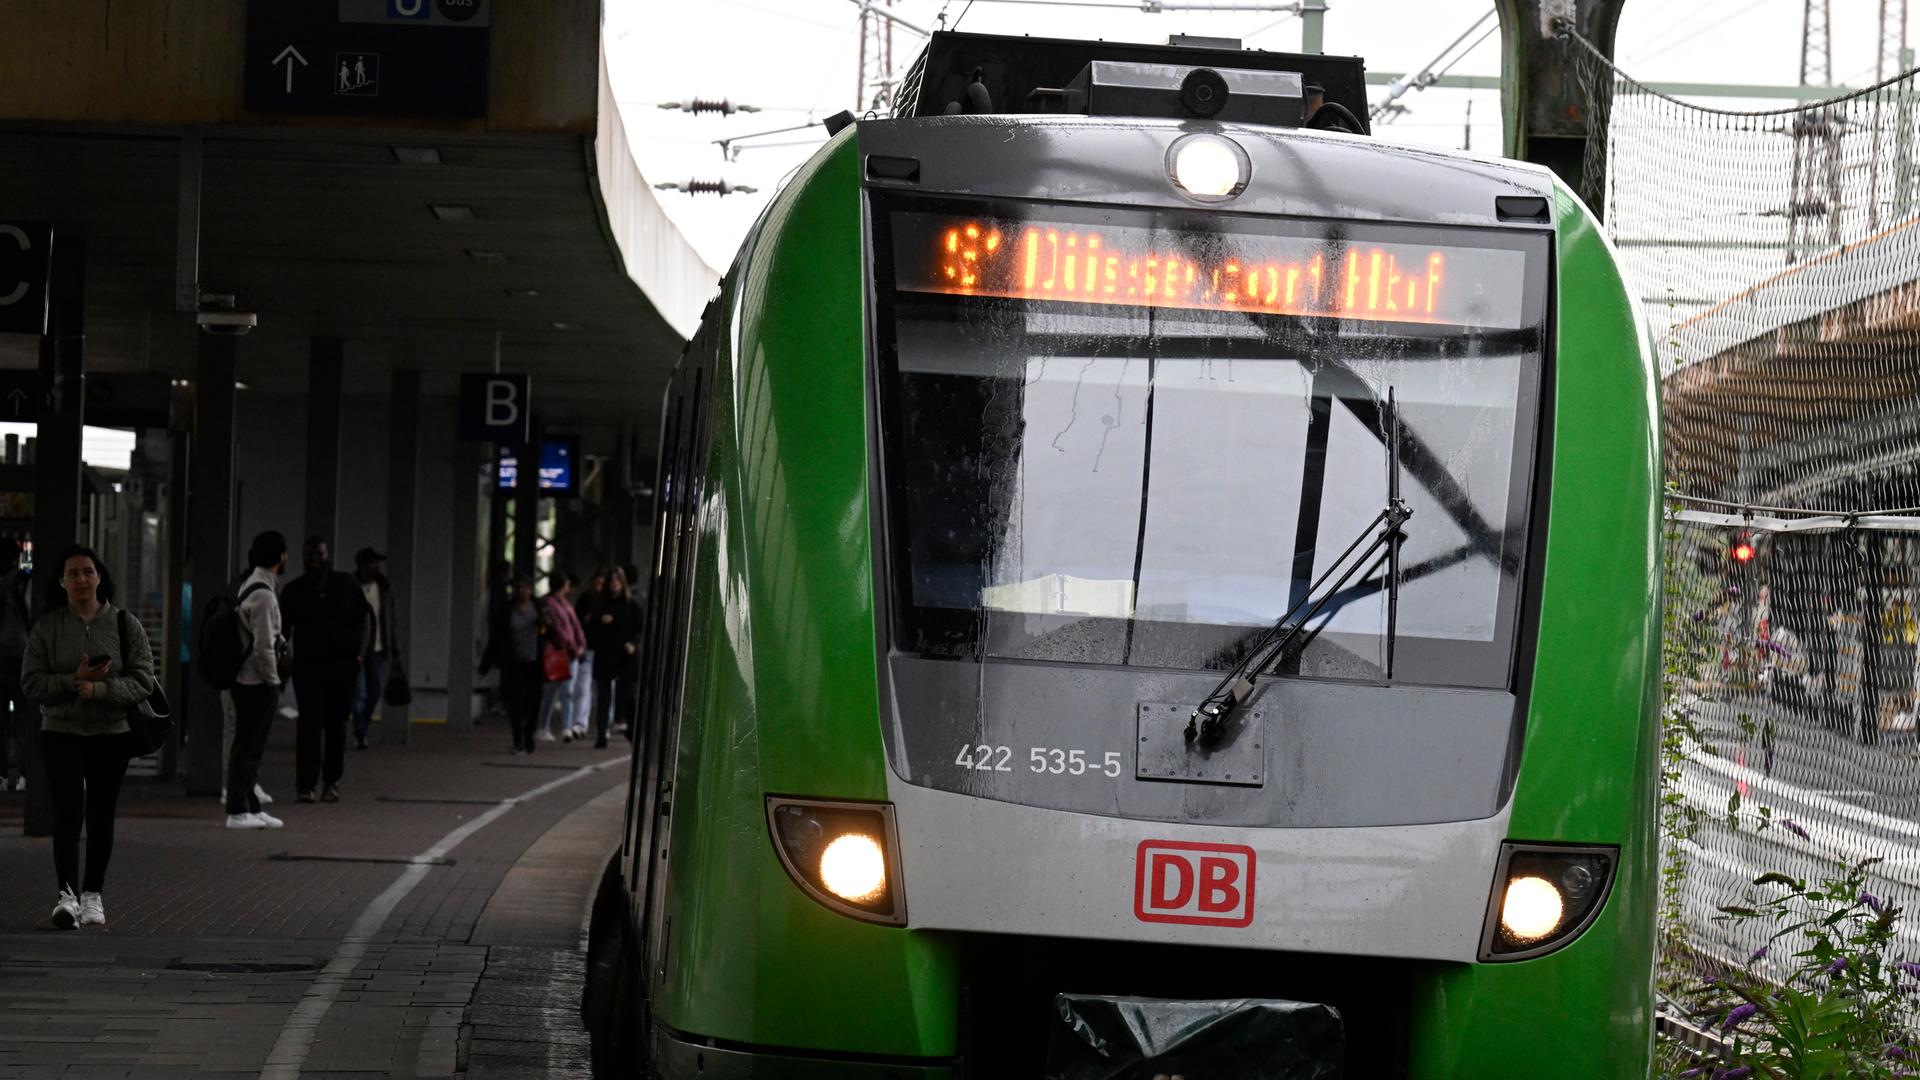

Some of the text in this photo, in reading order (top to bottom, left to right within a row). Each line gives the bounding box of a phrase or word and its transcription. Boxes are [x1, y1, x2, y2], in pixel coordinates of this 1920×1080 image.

[1023, 230, 1321, 305] Düsseorf
[484, 379, 519, 427] B
[955, 743, 1121, 778] 422 535-5
[1149, 853, 1241, 913] DB
